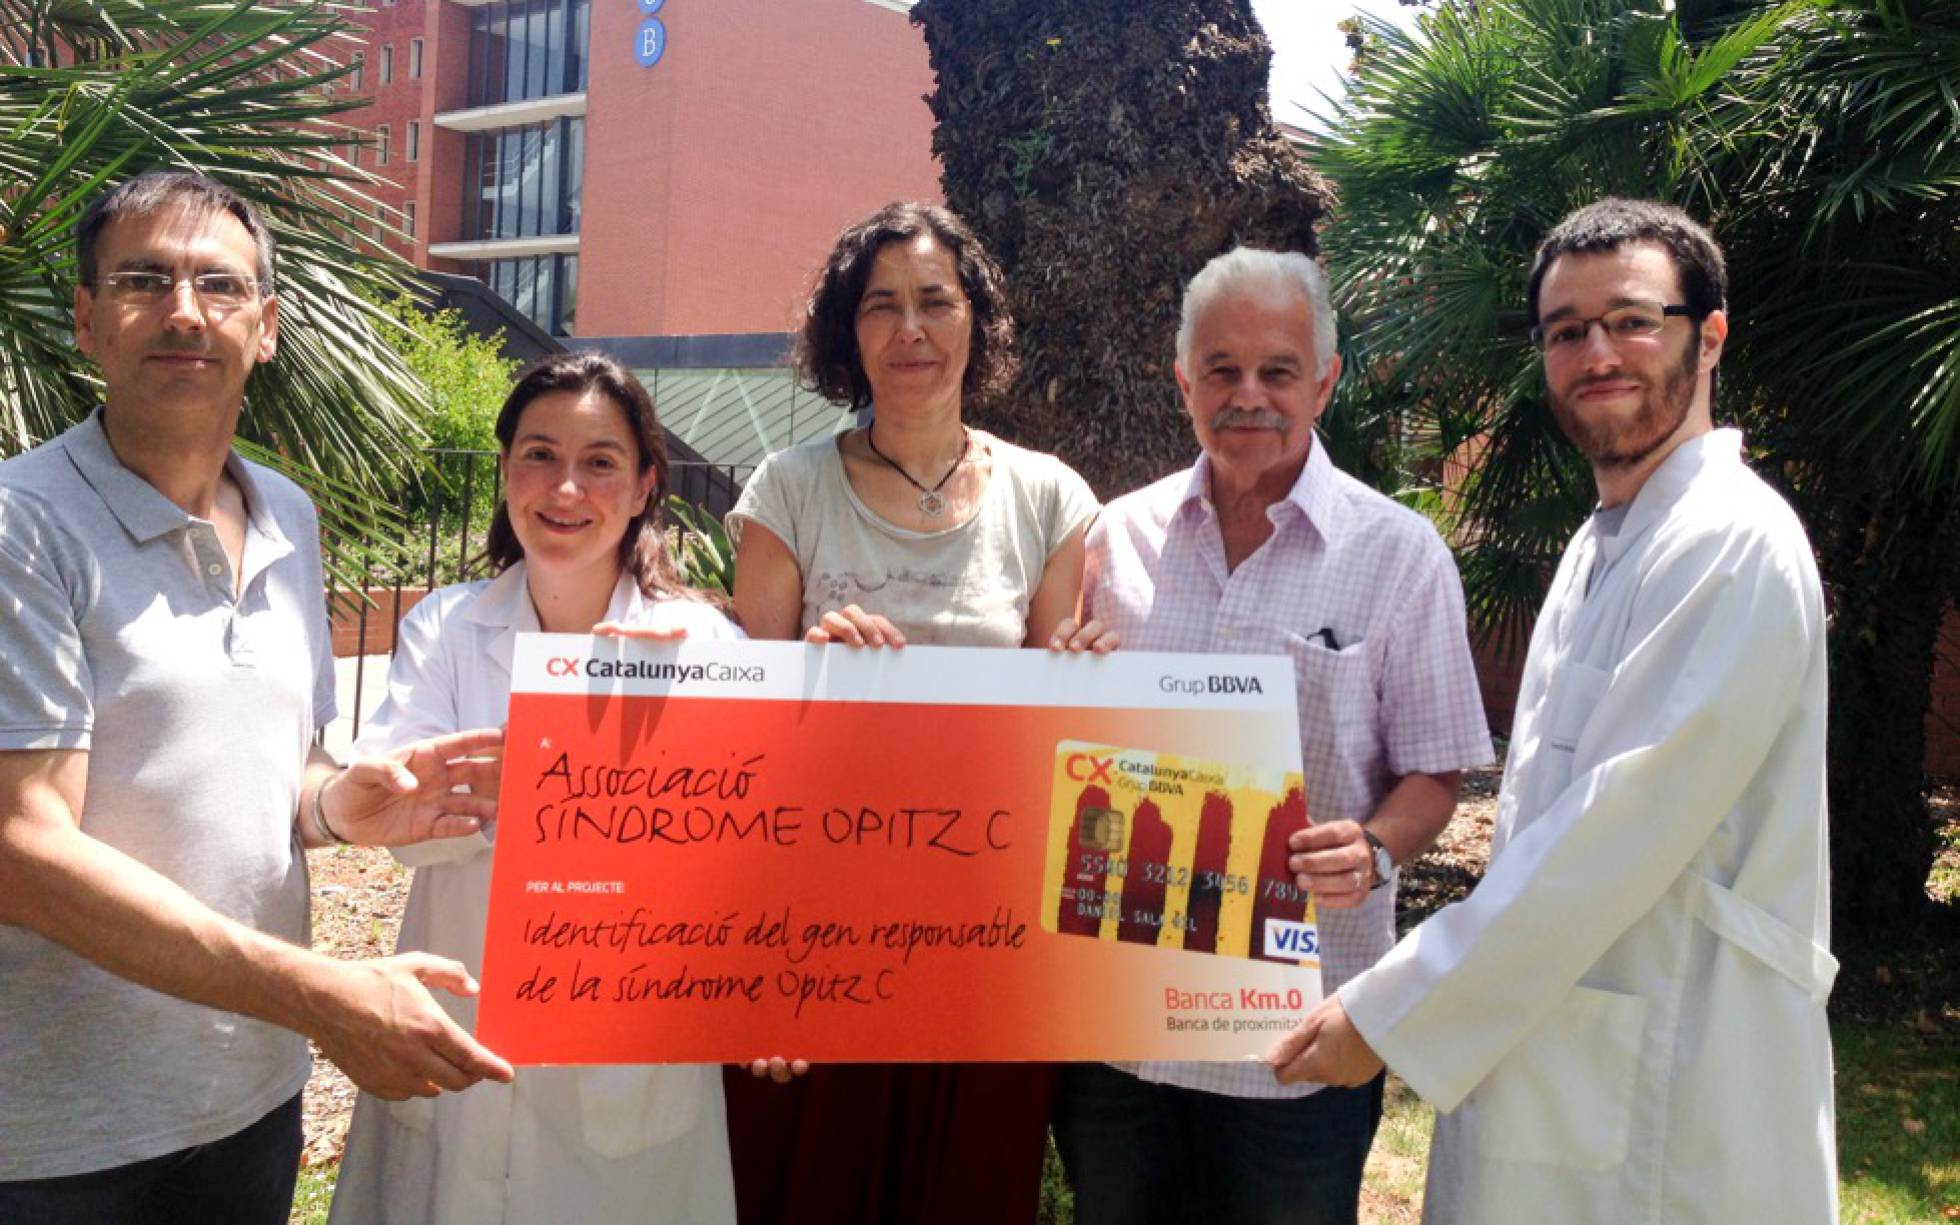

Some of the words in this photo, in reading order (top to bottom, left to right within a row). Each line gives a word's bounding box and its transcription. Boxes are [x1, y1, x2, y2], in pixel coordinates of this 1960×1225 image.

[642, 27, 657, 57] B
[546, 658, 580, 676] CX
[1159, 675, 1206, 695] Grup
[1208, 676, 1263, 694] BBVA
[536, 752, 765, 799] Associació
[1066, 753, 1114, 785] CX
[535, 797, 804, 847] SÍNDROME
[822, 808, 980, 857] OPITZ
[985, 810, 1013, 849] C
[526, 881, 549, 893] PER
[551, 881, 565, 893] AL
[524, 906, 739, 953] Identificació
[743, 904, 790, 950] del
[790, 924, 860, 965] gen
[869, 904, 1027, 965] responsable
[1274, 928, 1319, 954] VIS
[516, 967, 557, 1004] de
[570, 961, 601, 1002] la
[613, 964, 763, 1004] síndrome
[777, 972, 872, 1019] Opitz
[875, 969, 897, 1001] C
[1165, 988, 1233, 1011] Banca
[1240, 988, 1303, 1011] Km.0
[1166, 1016, 1209, 1031] Banca
[1212, 1016, 1230, 1031] de
[1232, 1016, 1302, 1035] proximita
